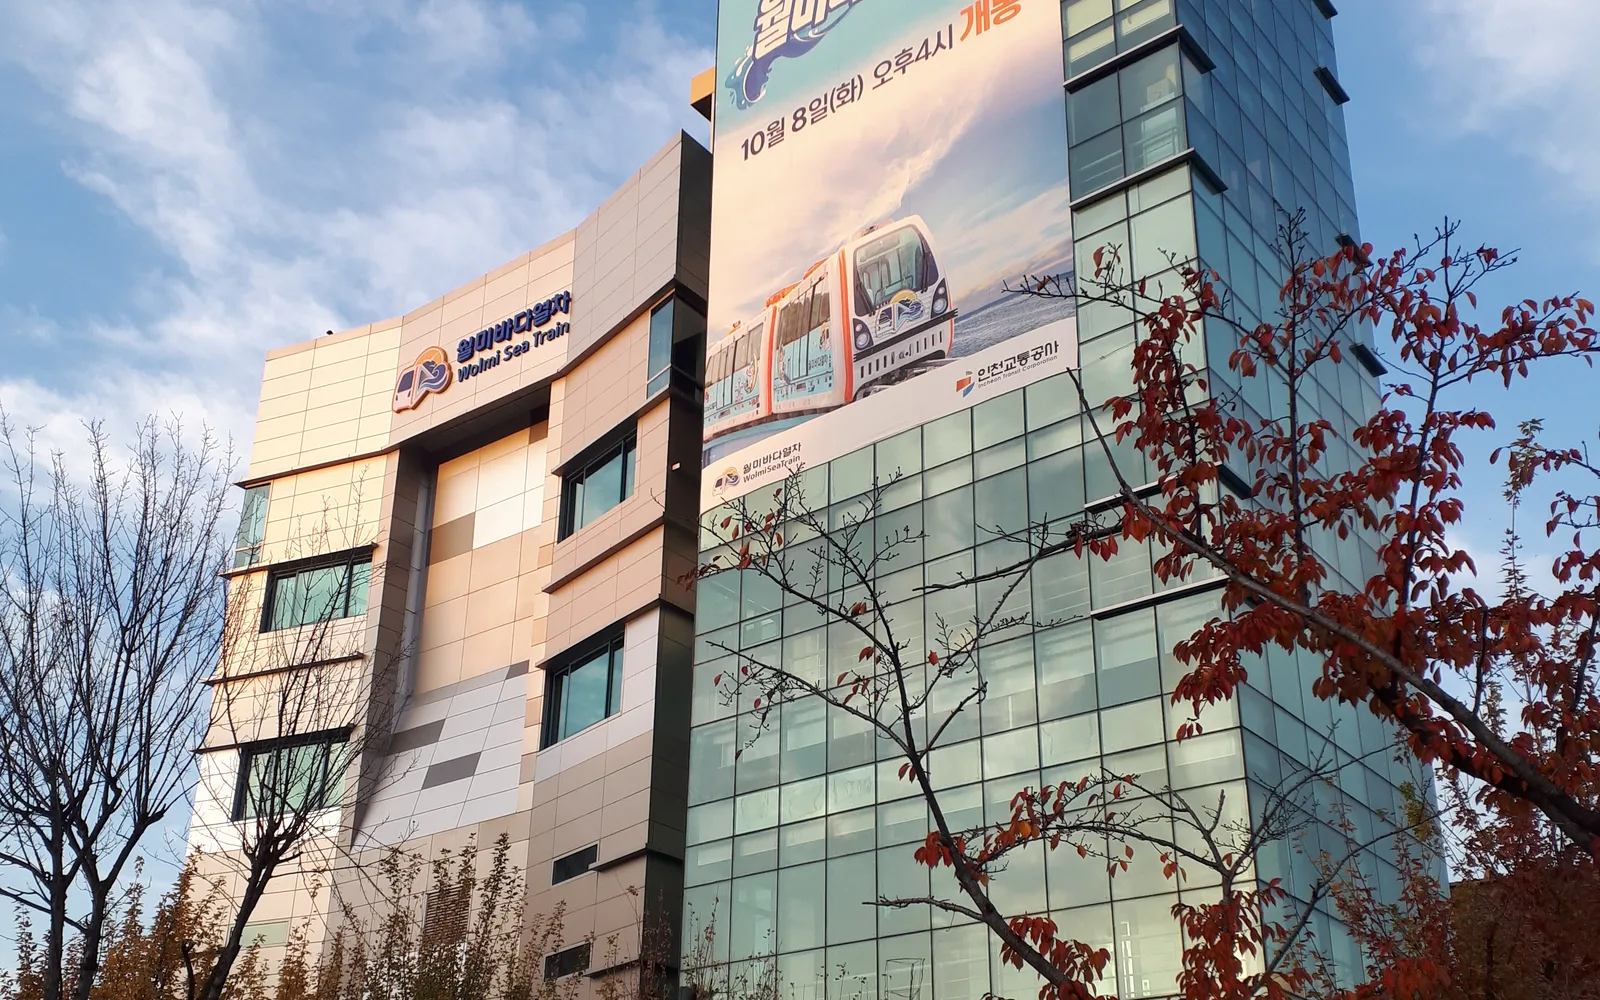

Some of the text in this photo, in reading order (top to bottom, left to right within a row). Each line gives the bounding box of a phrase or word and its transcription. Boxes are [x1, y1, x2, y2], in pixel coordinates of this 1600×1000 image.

[741, 117, 785, 161] 10월
[791, 74, 864, 133] 8일(화)
[872, 23, 953, 90] 오후4시
[456, 290, 572, 363] 월미바다열차
[457, 321, 570, 382] Wolmi Sea Train
[977, 340, 1059, 382] 인천교통공사
[978, 355, 1058, 388] Incheon Transit Corporation
[743, 441, 802, 475] 월미바다열차
